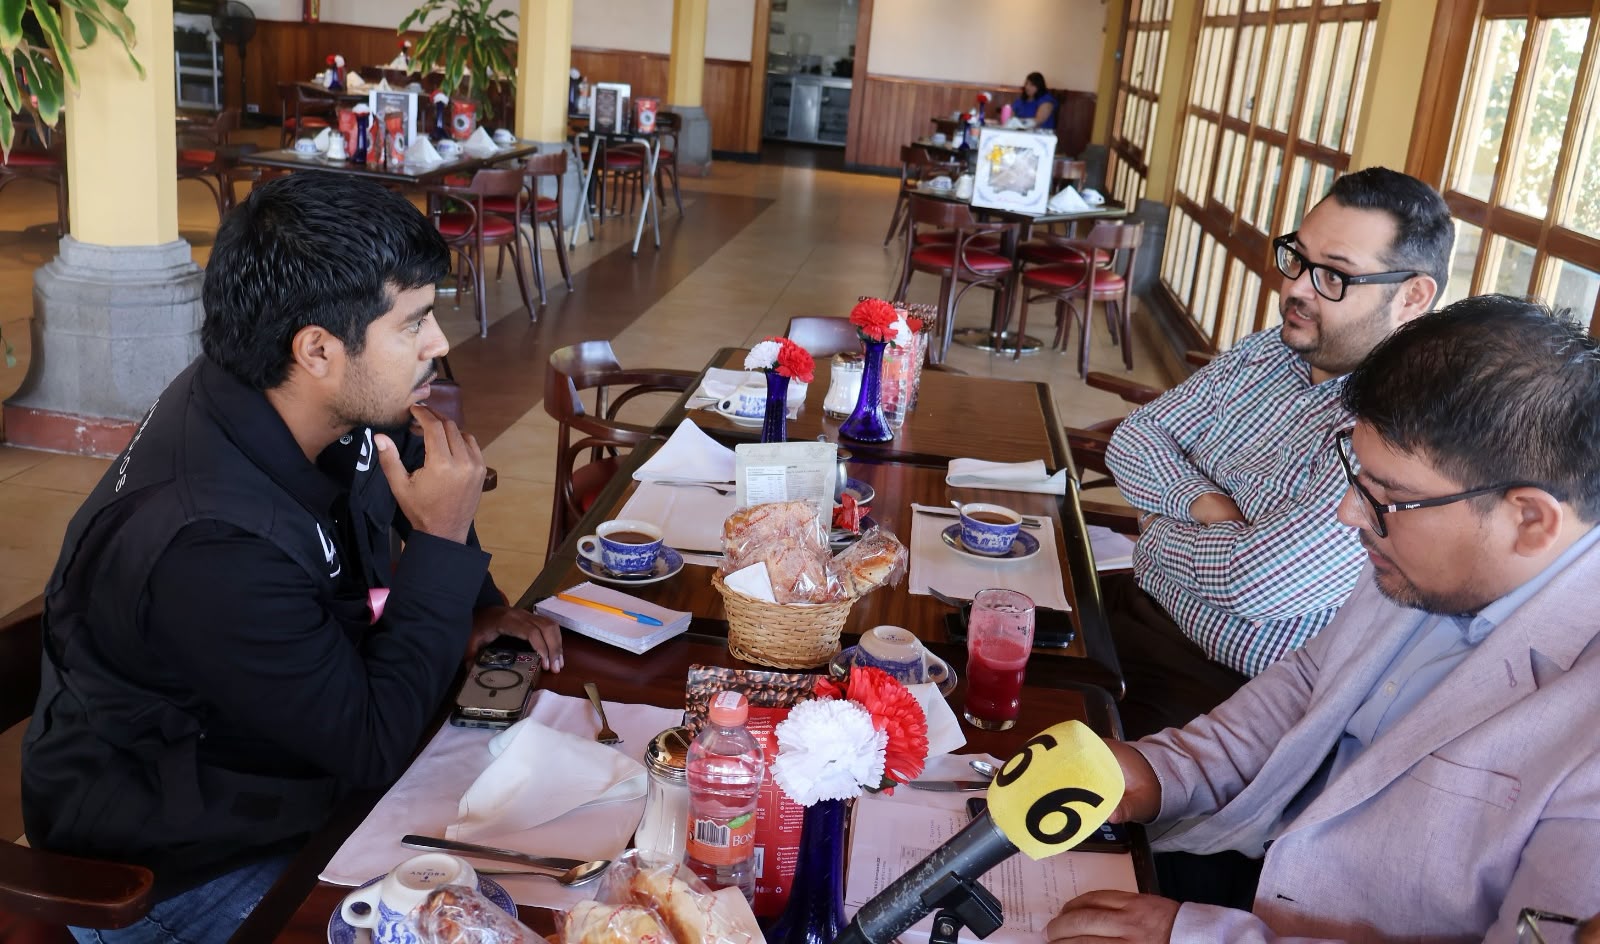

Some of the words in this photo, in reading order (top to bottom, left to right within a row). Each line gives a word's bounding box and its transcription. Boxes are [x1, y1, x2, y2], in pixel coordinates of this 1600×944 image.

[996, 734, 1058, 787] 6
[732, 830, 756, 847] BON
[1025, 787, 1105, 844] 6
